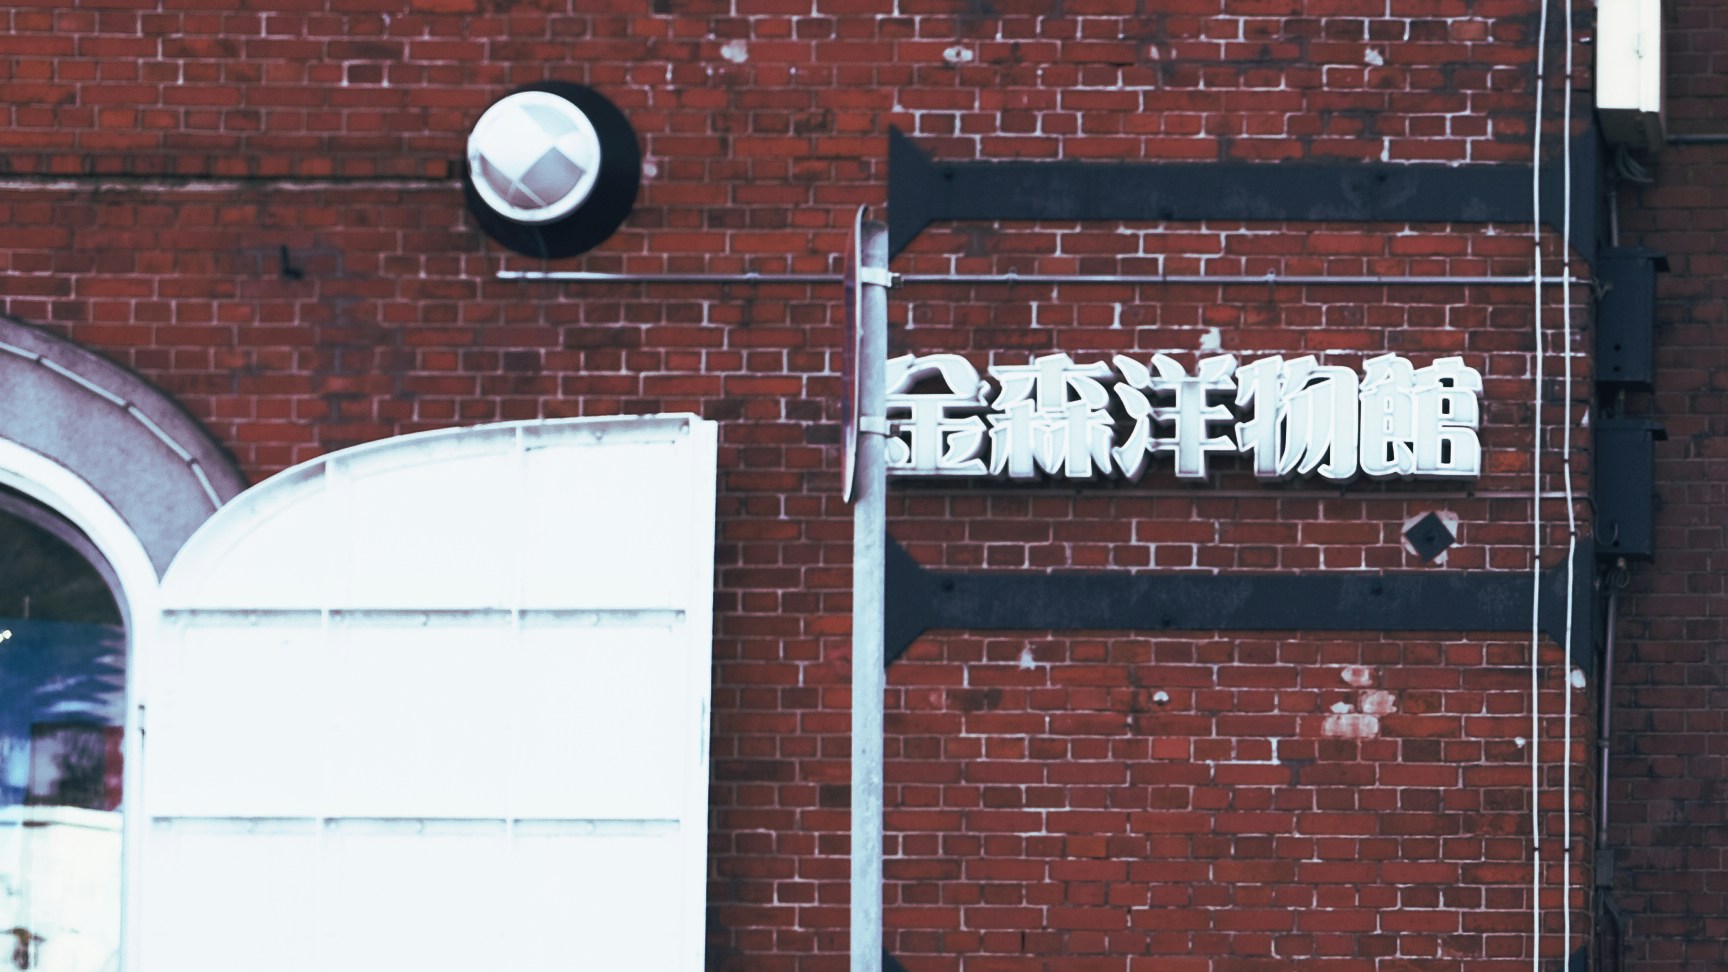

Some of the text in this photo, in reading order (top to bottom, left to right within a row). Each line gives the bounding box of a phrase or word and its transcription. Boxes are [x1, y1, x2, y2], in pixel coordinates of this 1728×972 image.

[885, 352, 1482, 480] 金森洋物館
